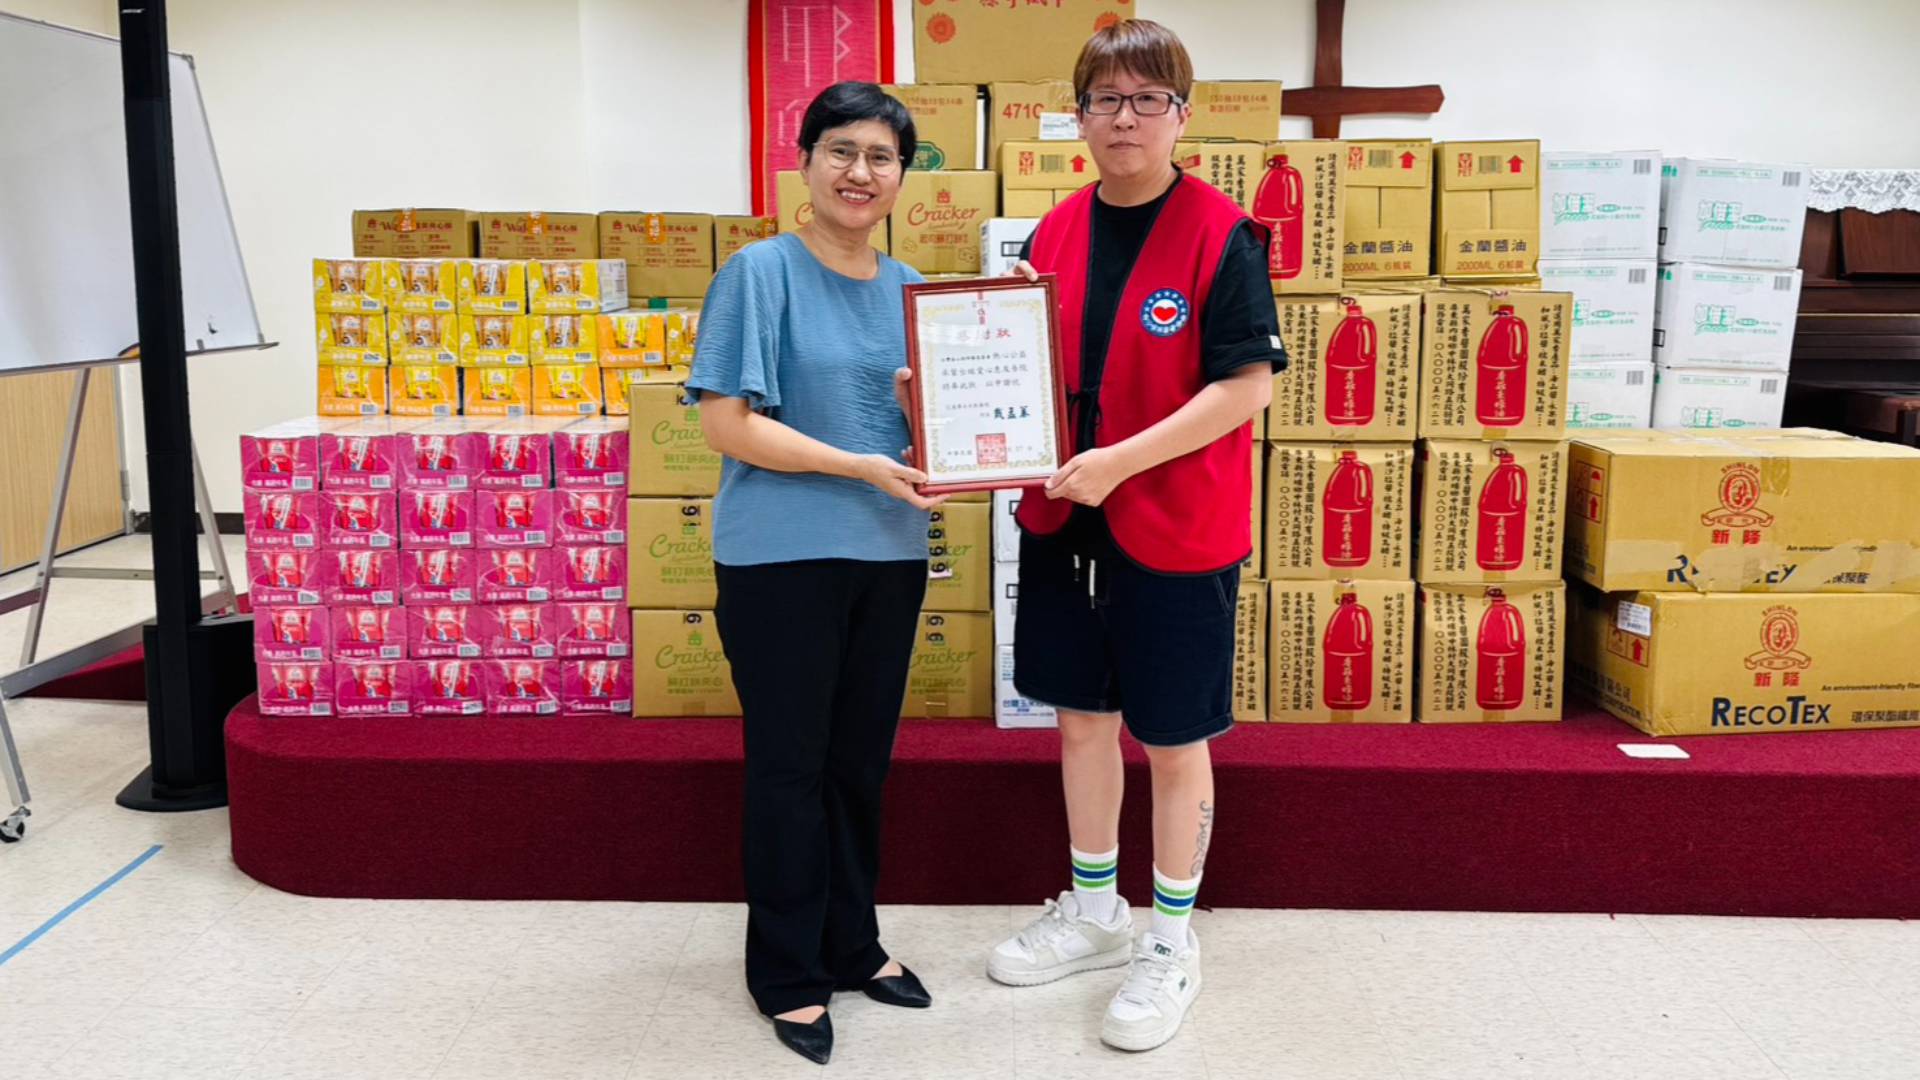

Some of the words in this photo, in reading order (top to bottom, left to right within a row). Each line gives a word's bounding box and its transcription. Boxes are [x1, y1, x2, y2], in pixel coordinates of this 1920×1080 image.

[907, 202, 980, 226] Cracker
[1344, 240, 1414, 255] 金蘭醬油
[1459, 239, 1528, 253] 金蘭醬油
[1456, 261, 1493, 271] 2000ML
[1712, 529, 1760, 545] 新隆
[655, 645, 723, 669] Cracke
[1754, 672, 1800, 687] 新隆
